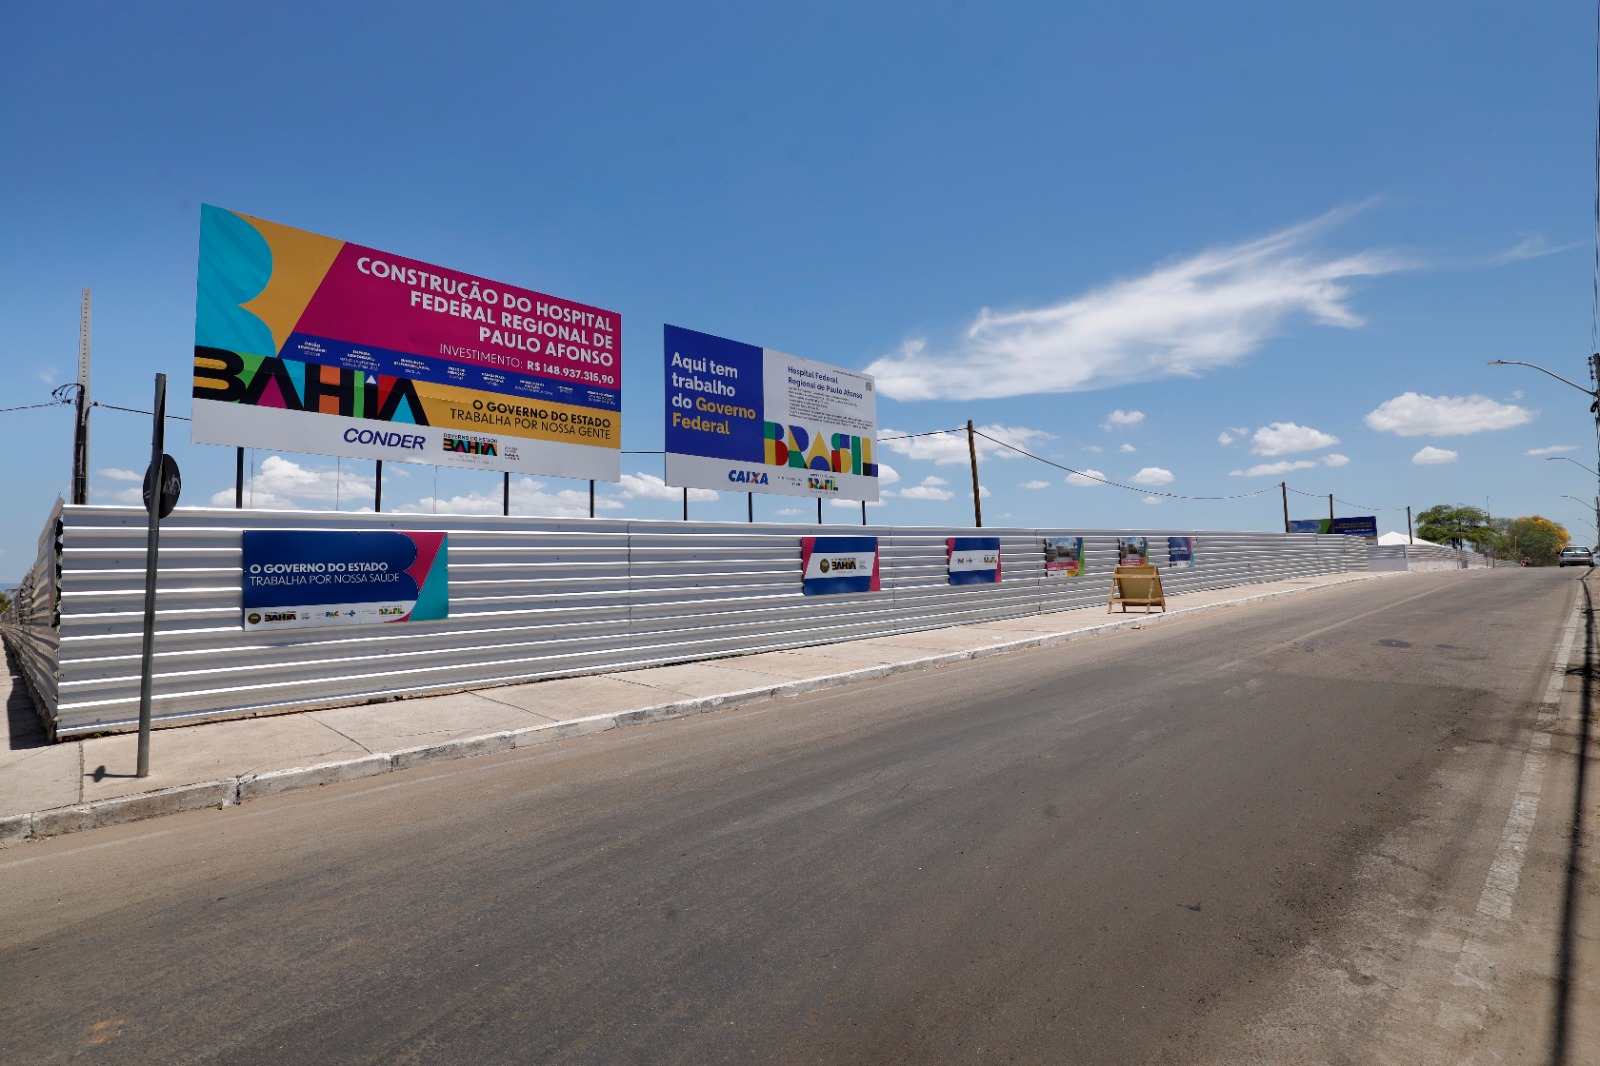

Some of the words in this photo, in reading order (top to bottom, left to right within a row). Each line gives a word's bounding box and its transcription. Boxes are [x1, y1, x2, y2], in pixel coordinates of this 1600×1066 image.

[357, 256, 498, 304] CONSTRUÇÃO
[503, 293, 532, 312] DO
[537, 300, 613, 332] HOSPITAL
[410, 290, 496, 324] FEDERAL
[502, 312, 589, 345] REGIONAL
[594, 333, 613, 350] DE
[480, 326, 540, 352] PAULO
[545, 342, 613, 367] AFONSO
[440, 344, 523, 369] INVESTIMENTO:
[527, 360, 540, 373] R$
[544, 362, 614, 385] 148.937.315,90
[672, 352, 706, 373] Aqui
[710, 360, 738, 378] tem
[788, 366, 814, 378] Hospital
[815, 373, 838, 384] Federal
[193, 344, 430, 426] BAHIA
[672, 372, 736, 397] trabalho
[788, 377, 816, 389] Regional
[826, 385, 842, 395] Paulo
[844, 389, 862, 399] Afonso
[473, 400, 483, 410] O
[487, 401, 548, 419] GOVERNO
[551, 411, 568, 422] DO
[571, 414, 611, 428] ESTADO
[672, 393, 692, 409] do
[696, 397, 756, 419] Governo
[450, 408, 511, 426] TRABALHA
[514, 415, 537, 430] POR
[542, 419, 575, 435] NOSSA
[578, 425, 610, 439] GENTE
[672, 412, 730, 434] Federal
[344, 428, 426, 450] CONDER
[443, 438, 497, 456] BAHIA
[764, 421, 878, 477] BRASIL
[728, 470, 768, 485] CAIXA
[808, 478, 838, 491] BRASIL
[249, 575, 307, 586] TRABALHA
[309, 574, 332, 584] POR
[334, 573, 367, 584] NOSSA
[369, 571, 400, 582] SAÚDE
[250, 564, 261, 574] O
[264, 563, 325, 574] GOVERNO
[328, 562, 346, 572] DO
[348, 562, 388, 572] ESTADO
[265, 614, 296, 622] BAHIA
